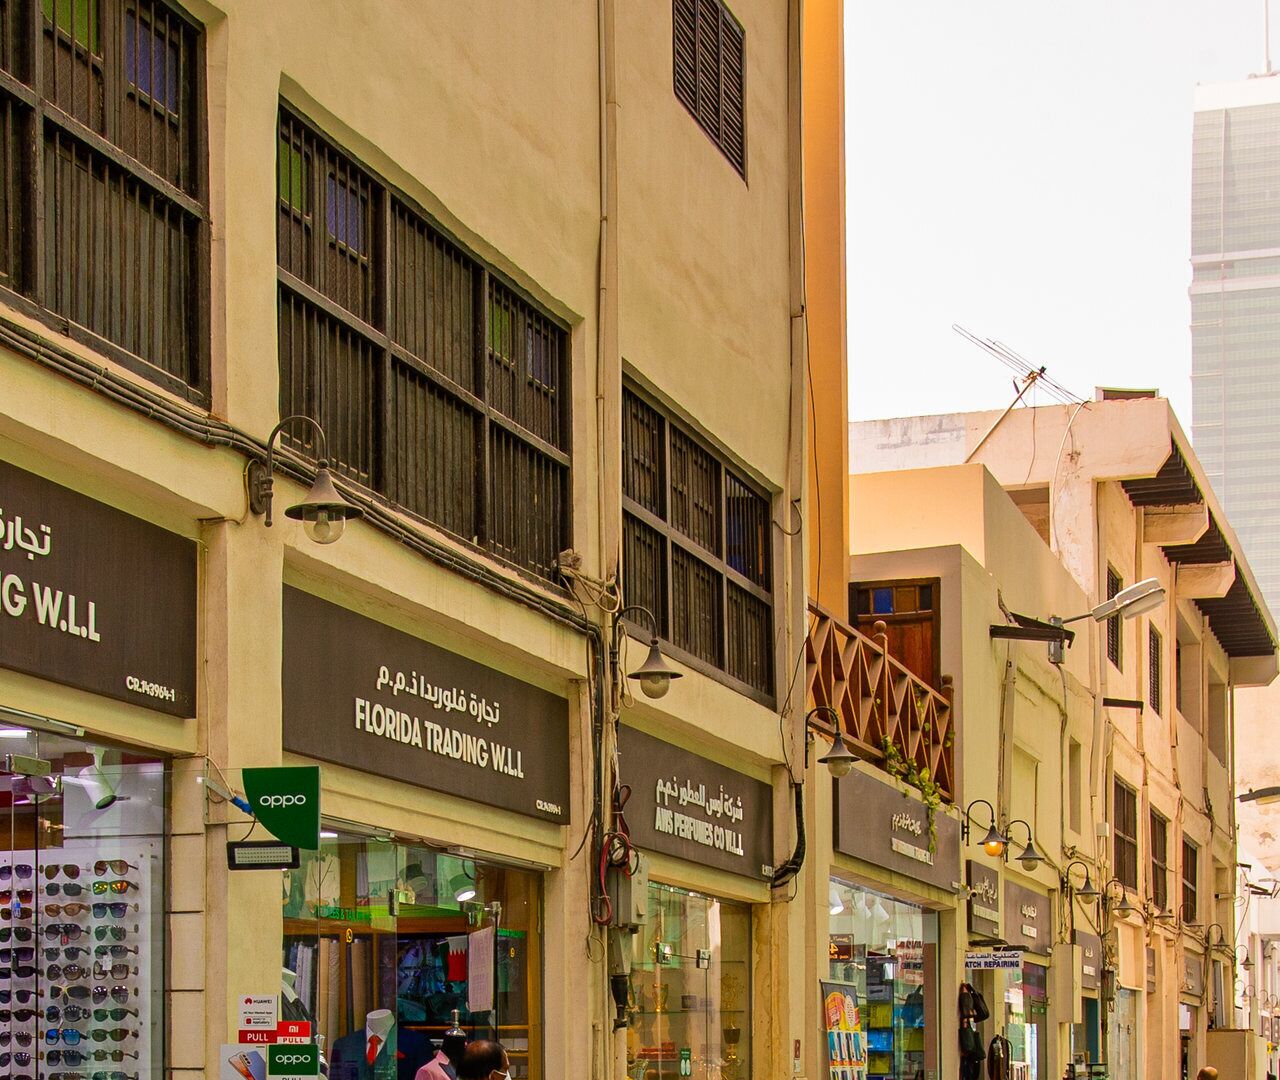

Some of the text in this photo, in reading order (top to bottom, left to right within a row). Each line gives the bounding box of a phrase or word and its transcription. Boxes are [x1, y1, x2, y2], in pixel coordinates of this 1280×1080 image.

[32, 582, 101, 643] W.L.L
[420, 675, 467, 713] فلوريدا
[469, 692, 500, 728] تجارة
[355, 697, 524, 779] FLORIDA TRADING W.L.L
[259, 791, 307, 808] oppo
[723, 794, 743, 823] شركة
[655, 806, 673, 834] AWS
[673, 812, 714, 847] PERFUMES
[984, 960, 1020, 968] REPAIRING
[247, 1033, 269, 1042] PULL
[275, 1054, 311, 1065] oppo
